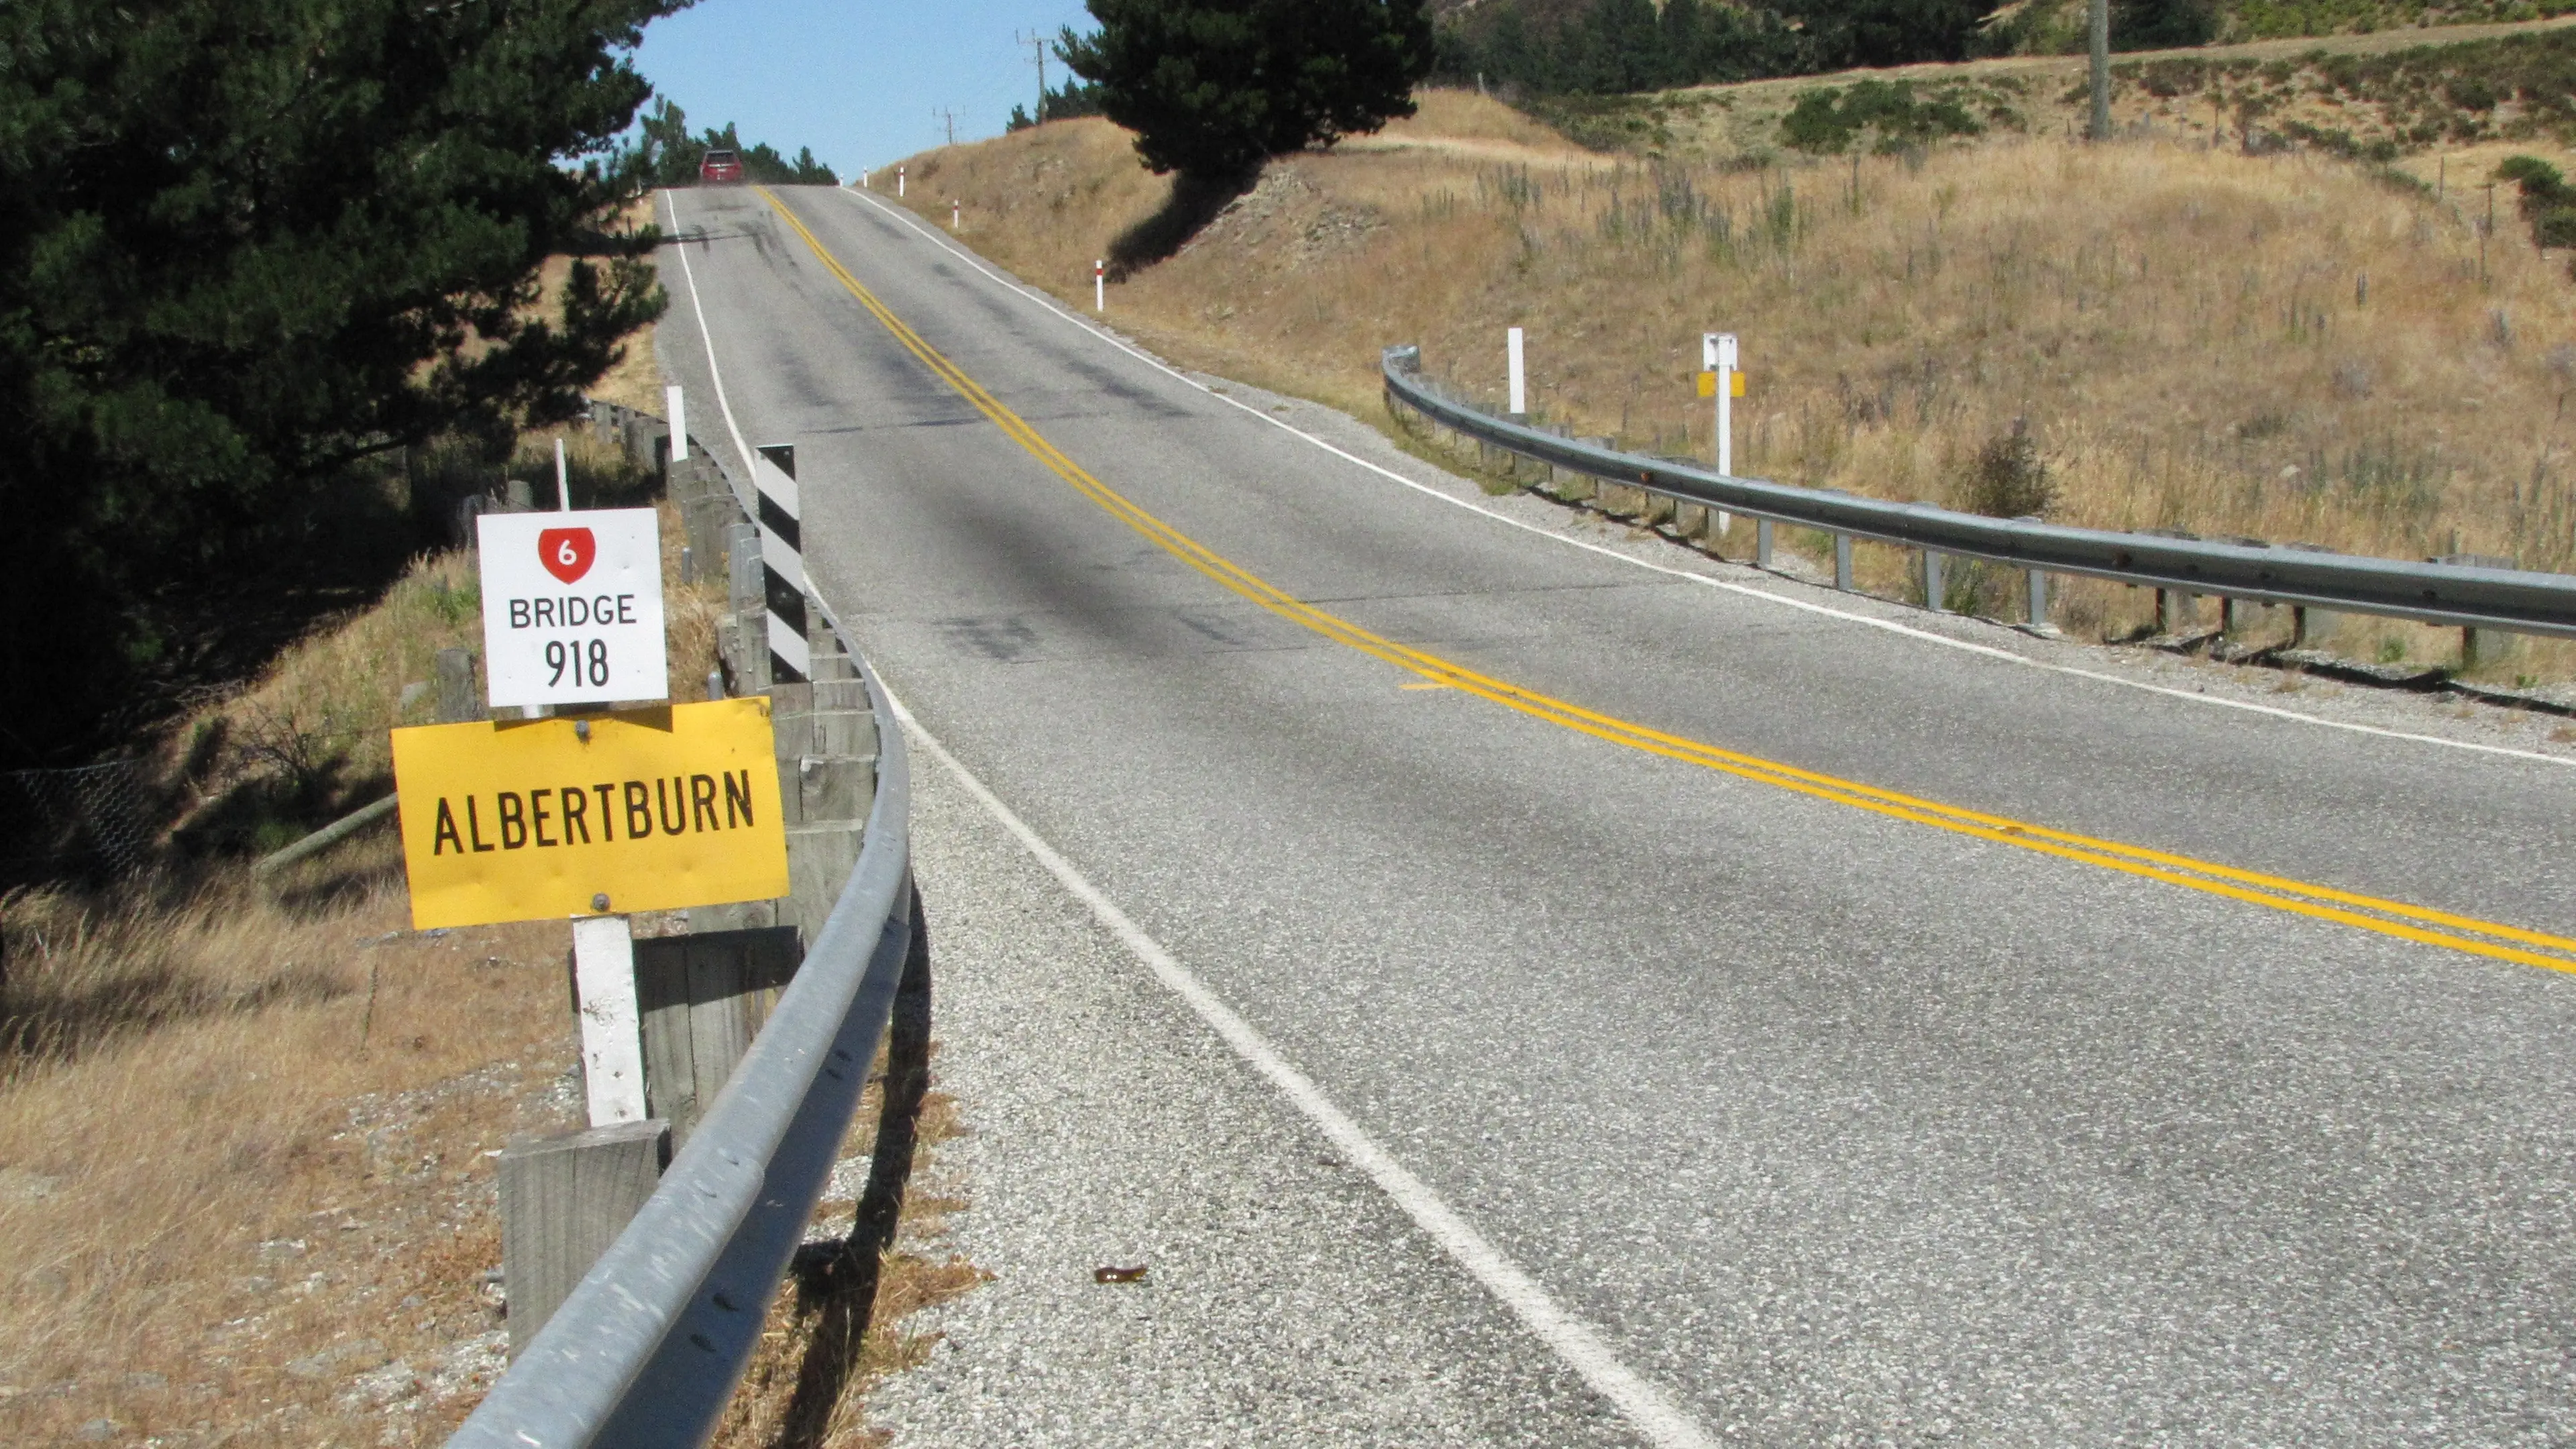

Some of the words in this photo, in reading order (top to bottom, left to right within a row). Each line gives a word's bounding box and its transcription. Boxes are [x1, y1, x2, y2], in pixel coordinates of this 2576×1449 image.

[558, 539, 577, 566] 6
[510, 594, 637, 629] BRIDGE
[545, 639, 609, 688] 918
[433, 769, 755, 856] ALBERTBURN
